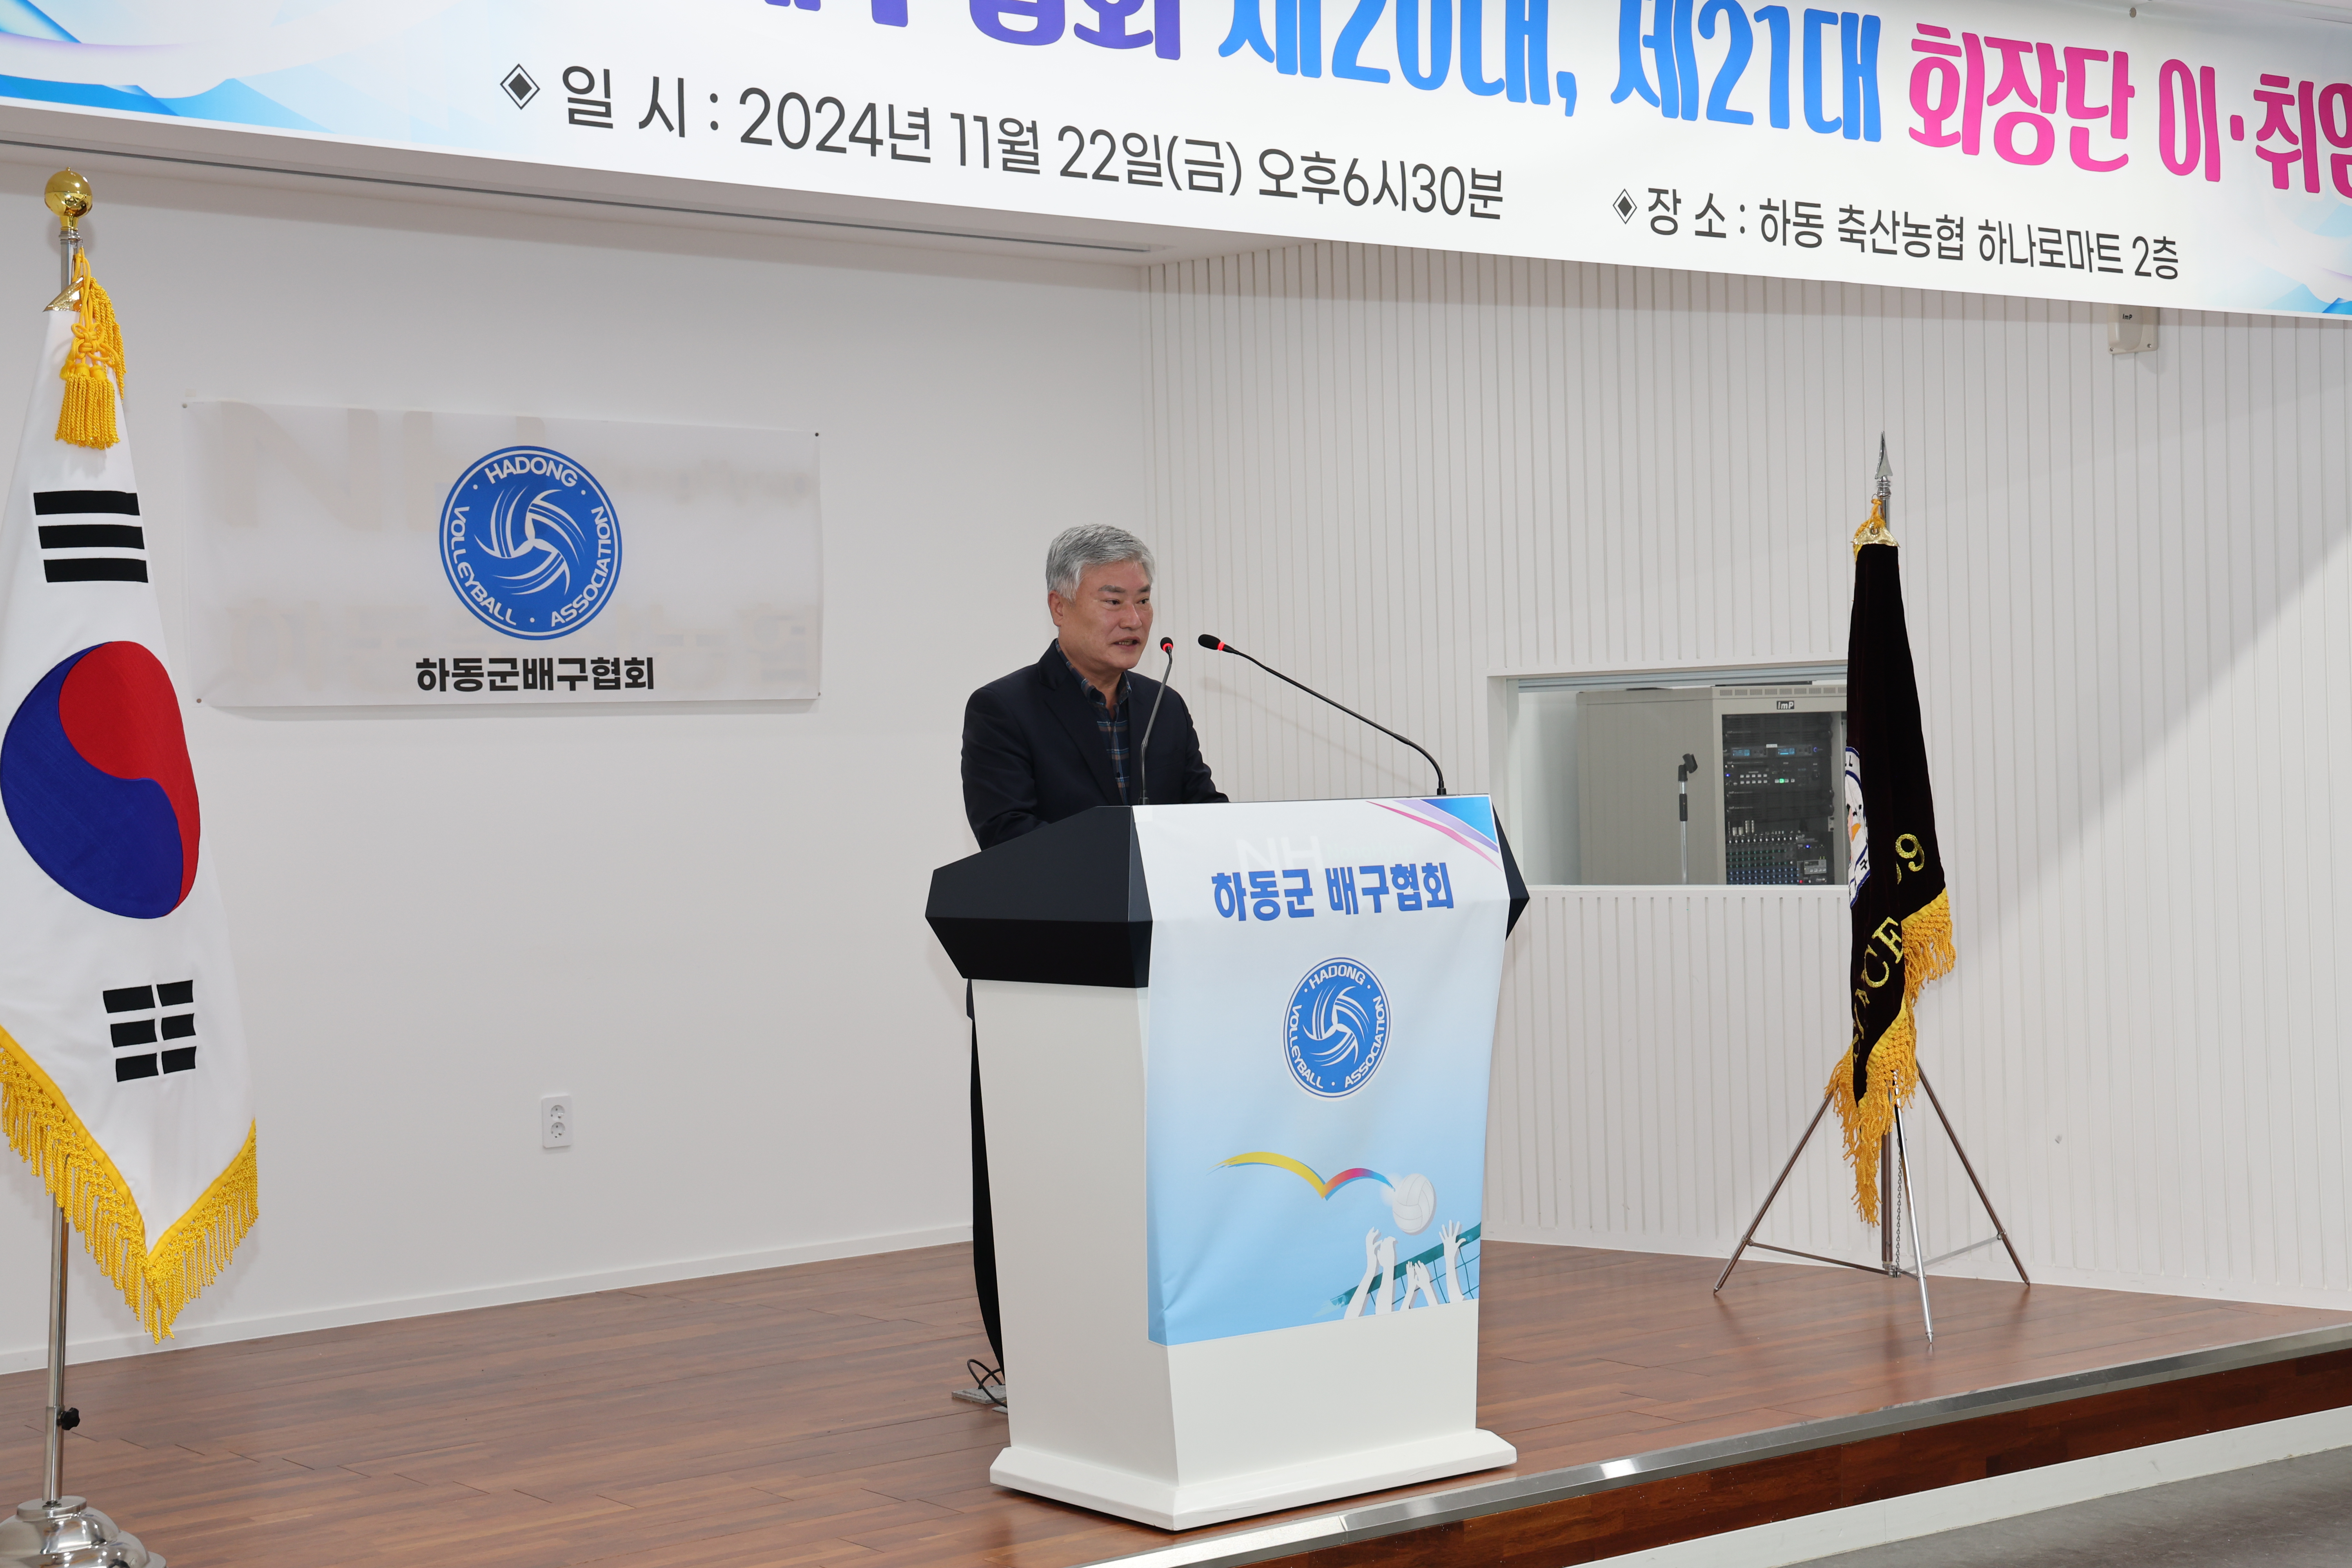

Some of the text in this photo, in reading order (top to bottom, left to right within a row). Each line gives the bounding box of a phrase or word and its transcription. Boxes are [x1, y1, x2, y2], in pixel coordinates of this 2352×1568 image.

[1610, 0, 1882, 142] 제21대
[1909, 23, 2135, 172] 회장단
[562, 65, 613, 129] 일
[638, 76, 686, 138] 시
[739, 87, 931, 164] 2024년
[950, 112, 1041, 175] 11월
[1058, 125, 1242, 196] 22일(금)
[1258, 148, 1503, 220] 오후6시30분
[1648, 187, 1682, 236] 장
[1694, 192, 1727, 239] 소
[1759, 198, 1824, 249] 하동
[1838, 204, 1964, 261] 축산농협
[1978, 219, 2124, 274] 하나로마트
[2132, 236, 2179, 280] 2층
[484, 456, 578, 487] HADONG
[450, 506, 517, 626] VOLLEYBALL
[550, 506, 612, 627] ASSOCIATION
[416, 657, 654, 692] 하동군배구협회
[1211, 862, 1454, 922] 하동군 배구협회
[1308, 964, 1366, 990] HADONG
[1289, 1004, 1324, 1089] VOLLEYBALL
[1344, 995, 1385, 1088] ASSOCIATION
